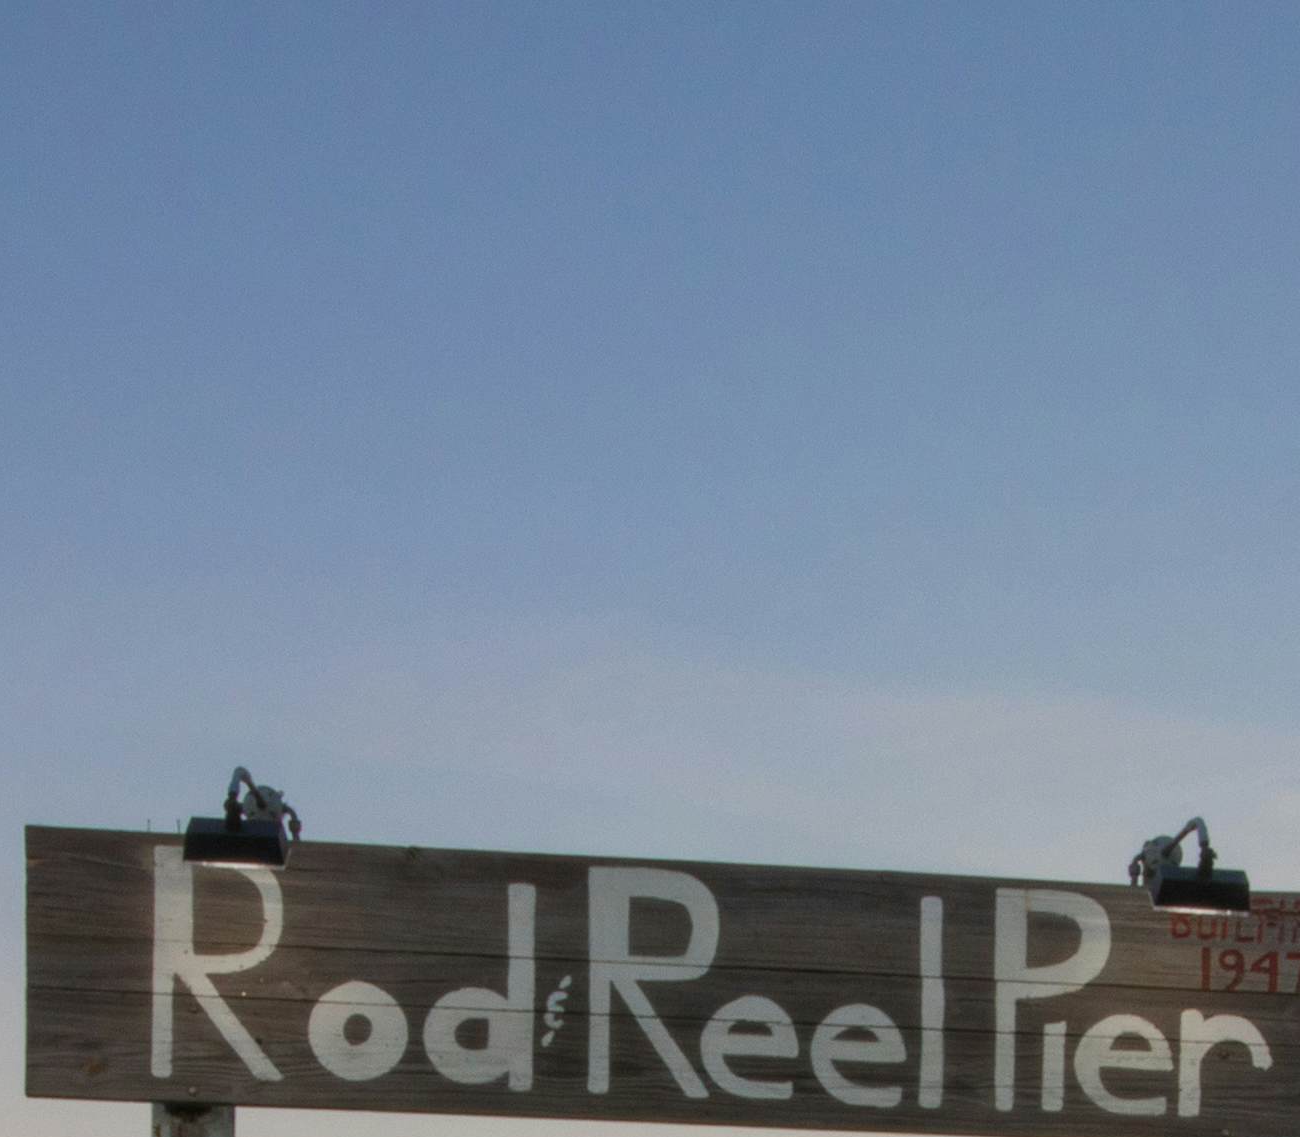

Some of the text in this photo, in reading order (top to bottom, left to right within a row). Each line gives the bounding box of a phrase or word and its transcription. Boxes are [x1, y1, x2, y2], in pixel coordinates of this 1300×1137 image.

[150, 845, 537, 1093] Rod
[587, 866, 944, 1110] Reel
[994, 888, 1274, 1118] Pier
